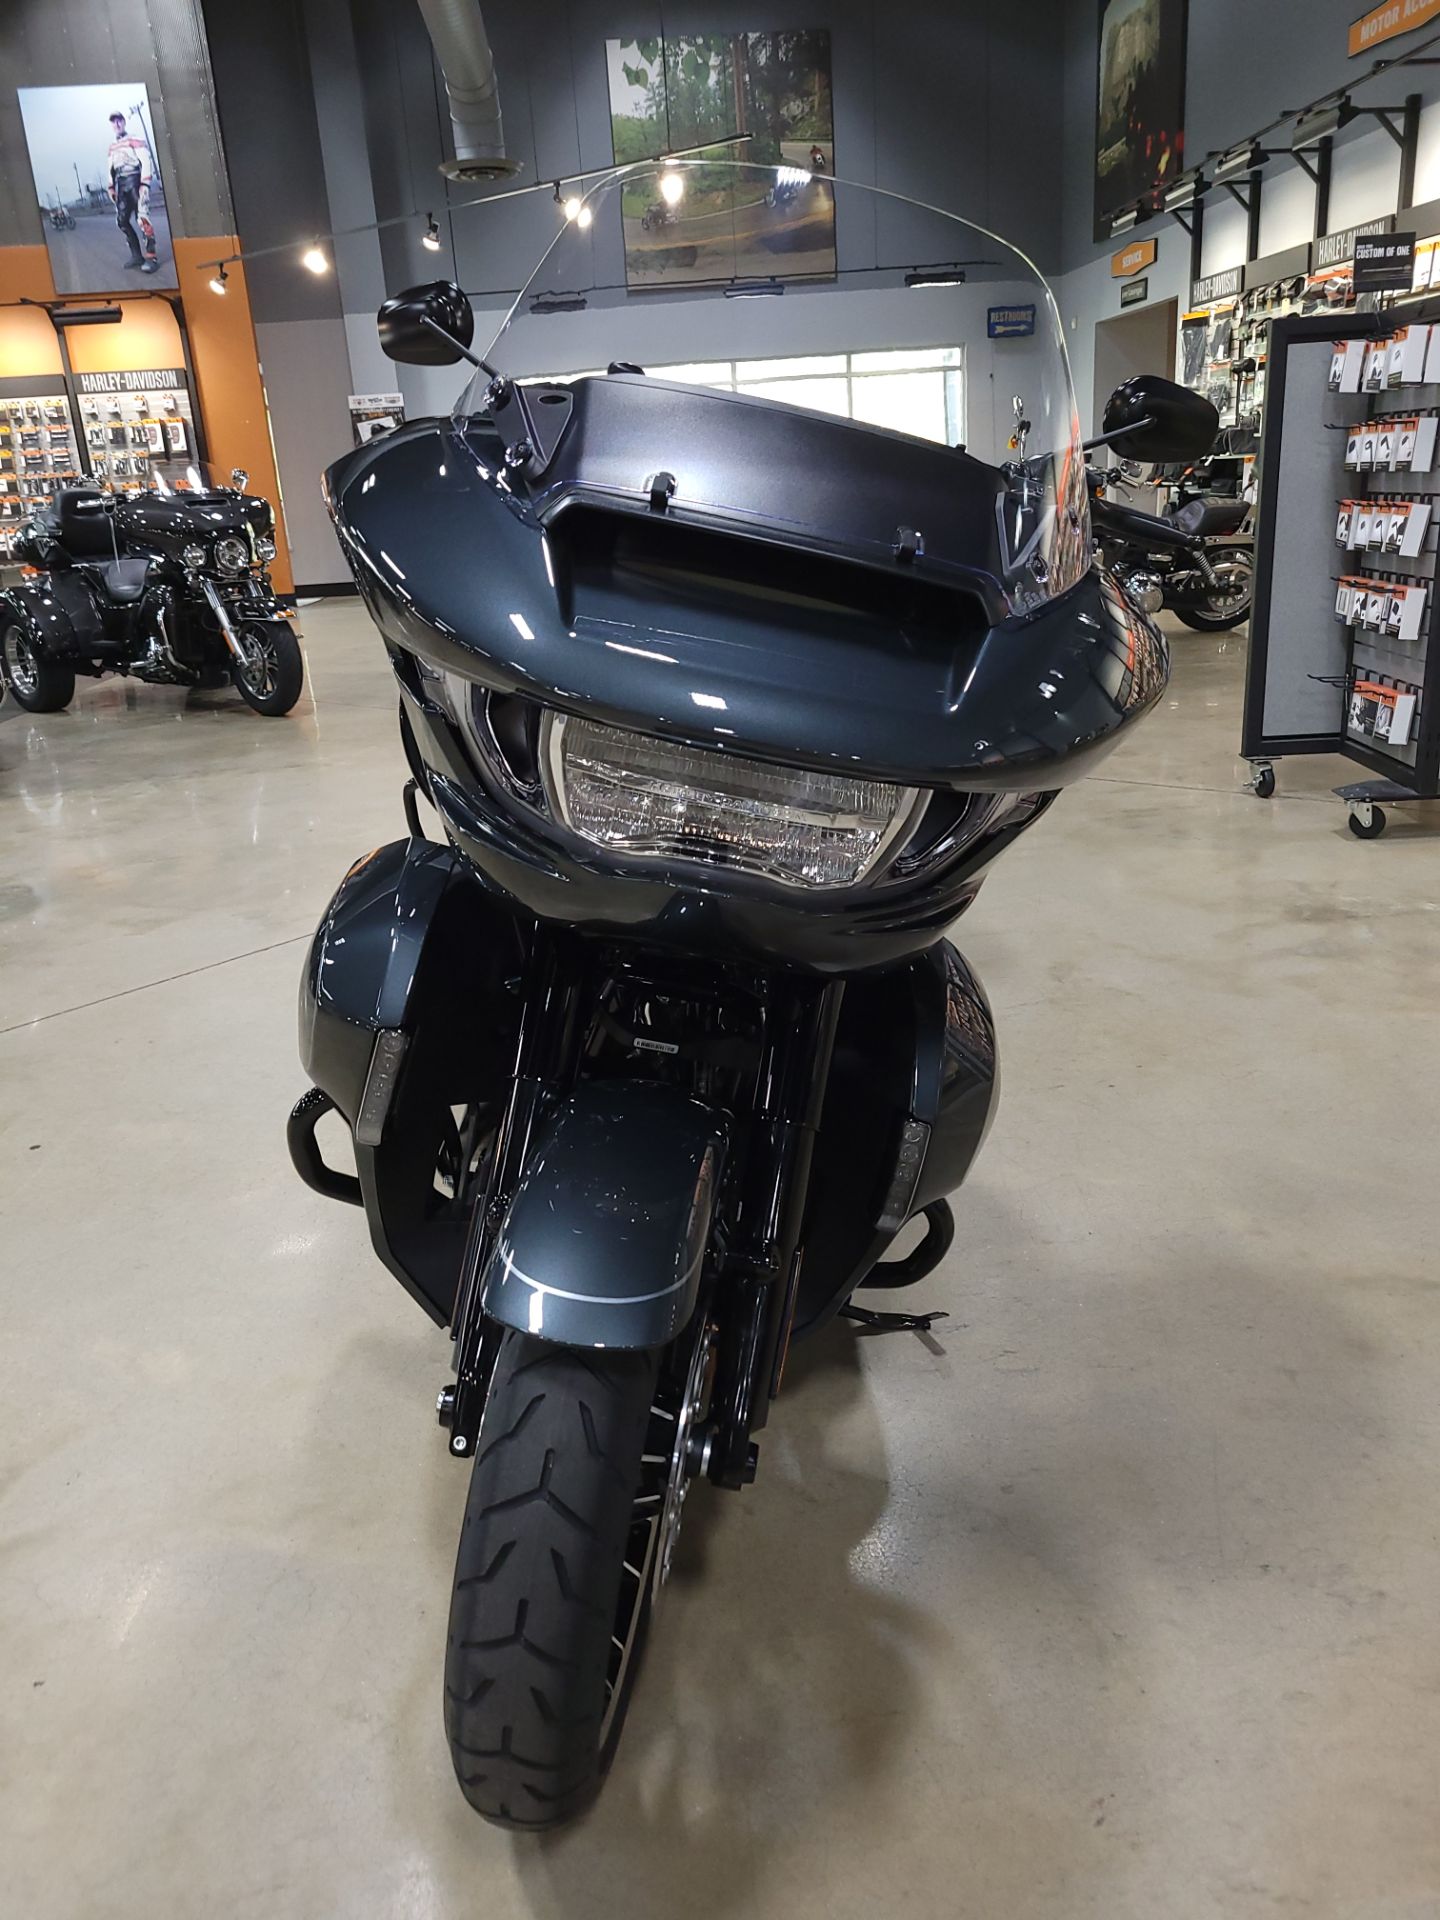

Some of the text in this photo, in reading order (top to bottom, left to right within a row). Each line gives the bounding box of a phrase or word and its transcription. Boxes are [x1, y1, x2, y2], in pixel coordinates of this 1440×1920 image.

[1360, 0, 1435, 43] MOTOR ACC
[1122, 250, 1142, 268] SERVICE
[1356, 245, 1410, 259] CUSTOM OF ONE
[1193, 270, 1238, 302] HARLEY-DAVIDSON
[81, 370, 177, 392] HARLEY-DAVIDSON
